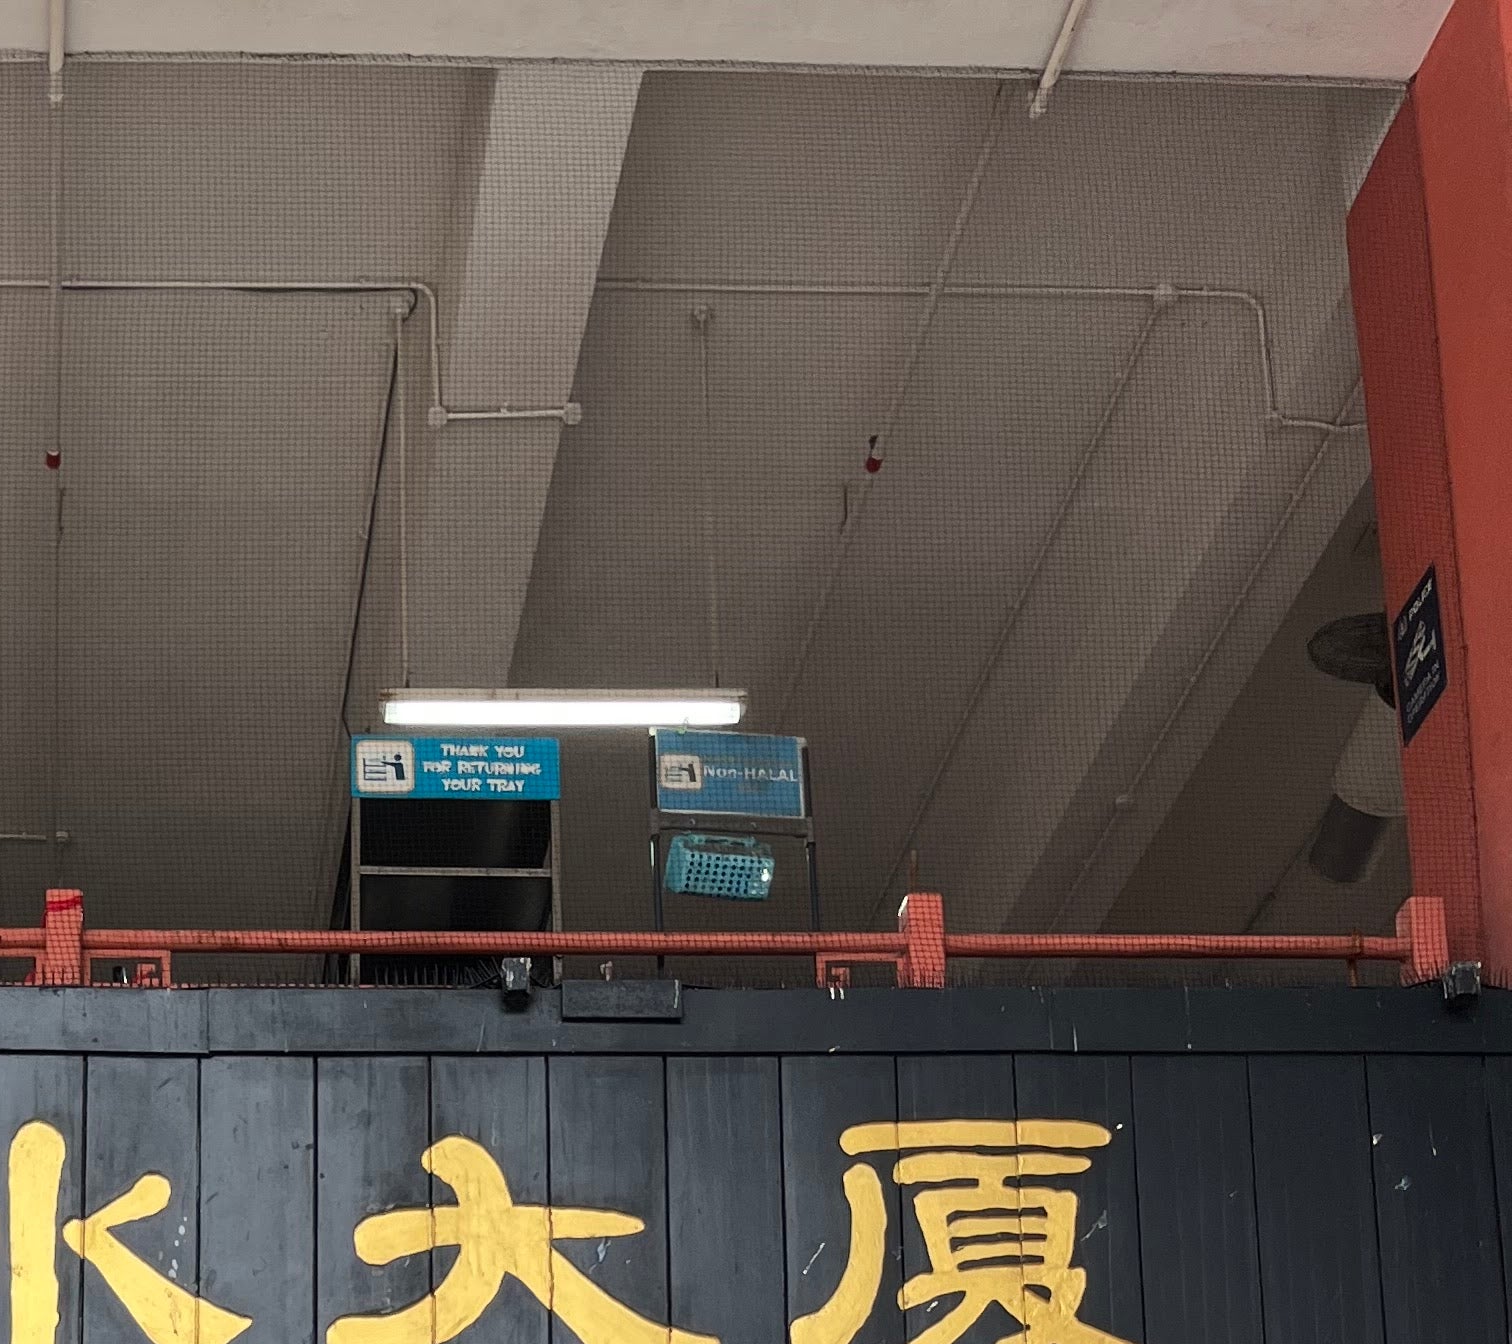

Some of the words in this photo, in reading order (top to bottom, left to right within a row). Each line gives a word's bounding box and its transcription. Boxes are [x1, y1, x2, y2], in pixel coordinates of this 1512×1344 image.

[440, 743, 488, 757] THANK
[494, 745, 525, 758] YOU
[423, 760, 452, 773] FOR
[457, 761, 542, 776] RETURNING
[441, 778, 483, 792] YOUR
[487, 779, 525, 792] TRAY
